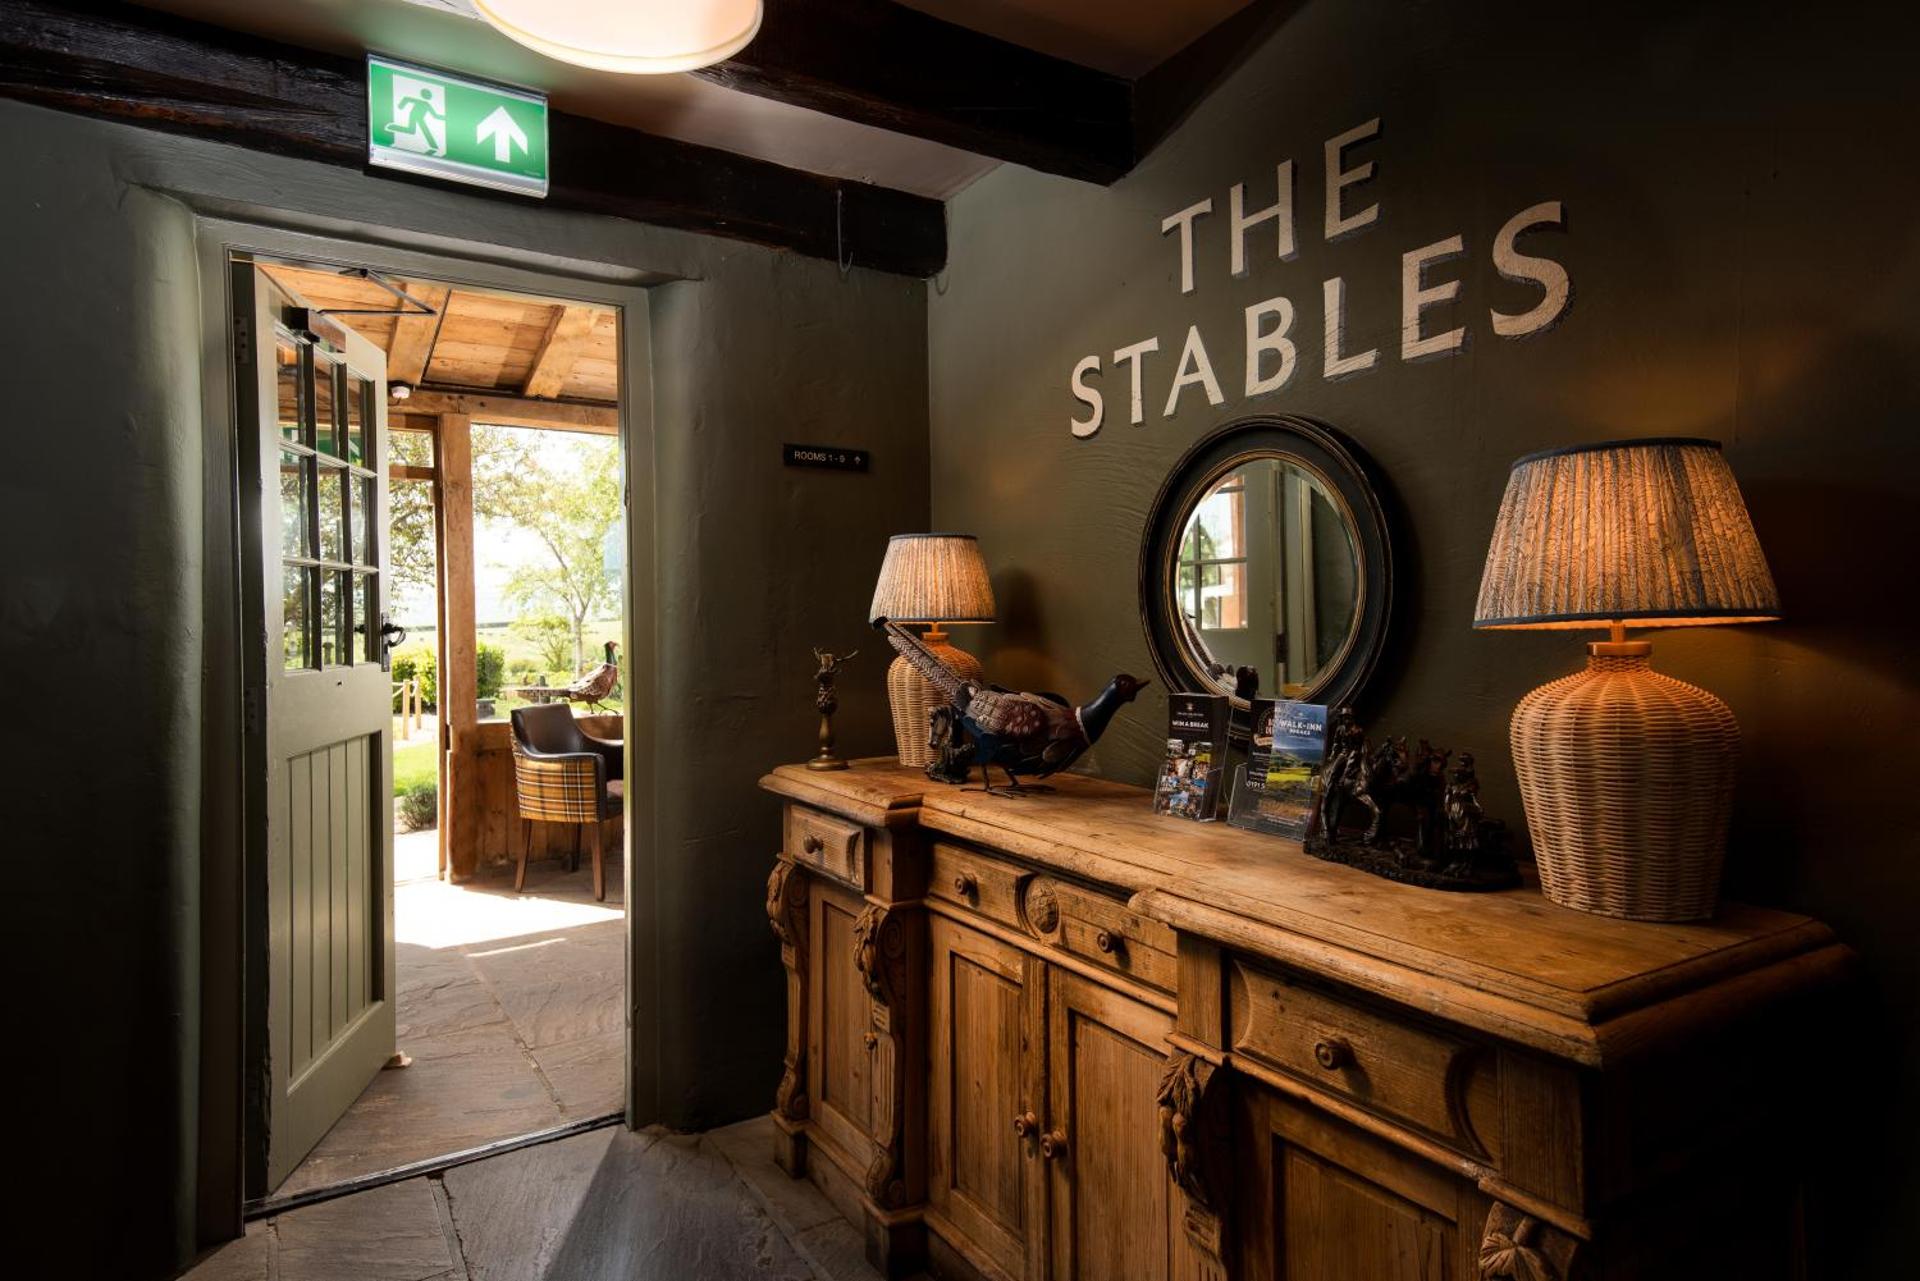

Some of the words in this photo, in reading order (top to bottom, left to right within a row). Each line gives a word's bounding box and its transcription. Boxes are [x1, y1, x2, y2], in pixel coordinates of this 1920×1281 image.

[1162, 117, 1382, 295] THE
[1070, 201, 1573, 439] STABLES
[794, 450, 827, 462] ROOMS
[1190, 721, 1209, 729] BREAK
[1279, 719, 1322, 732] WALK-INN
